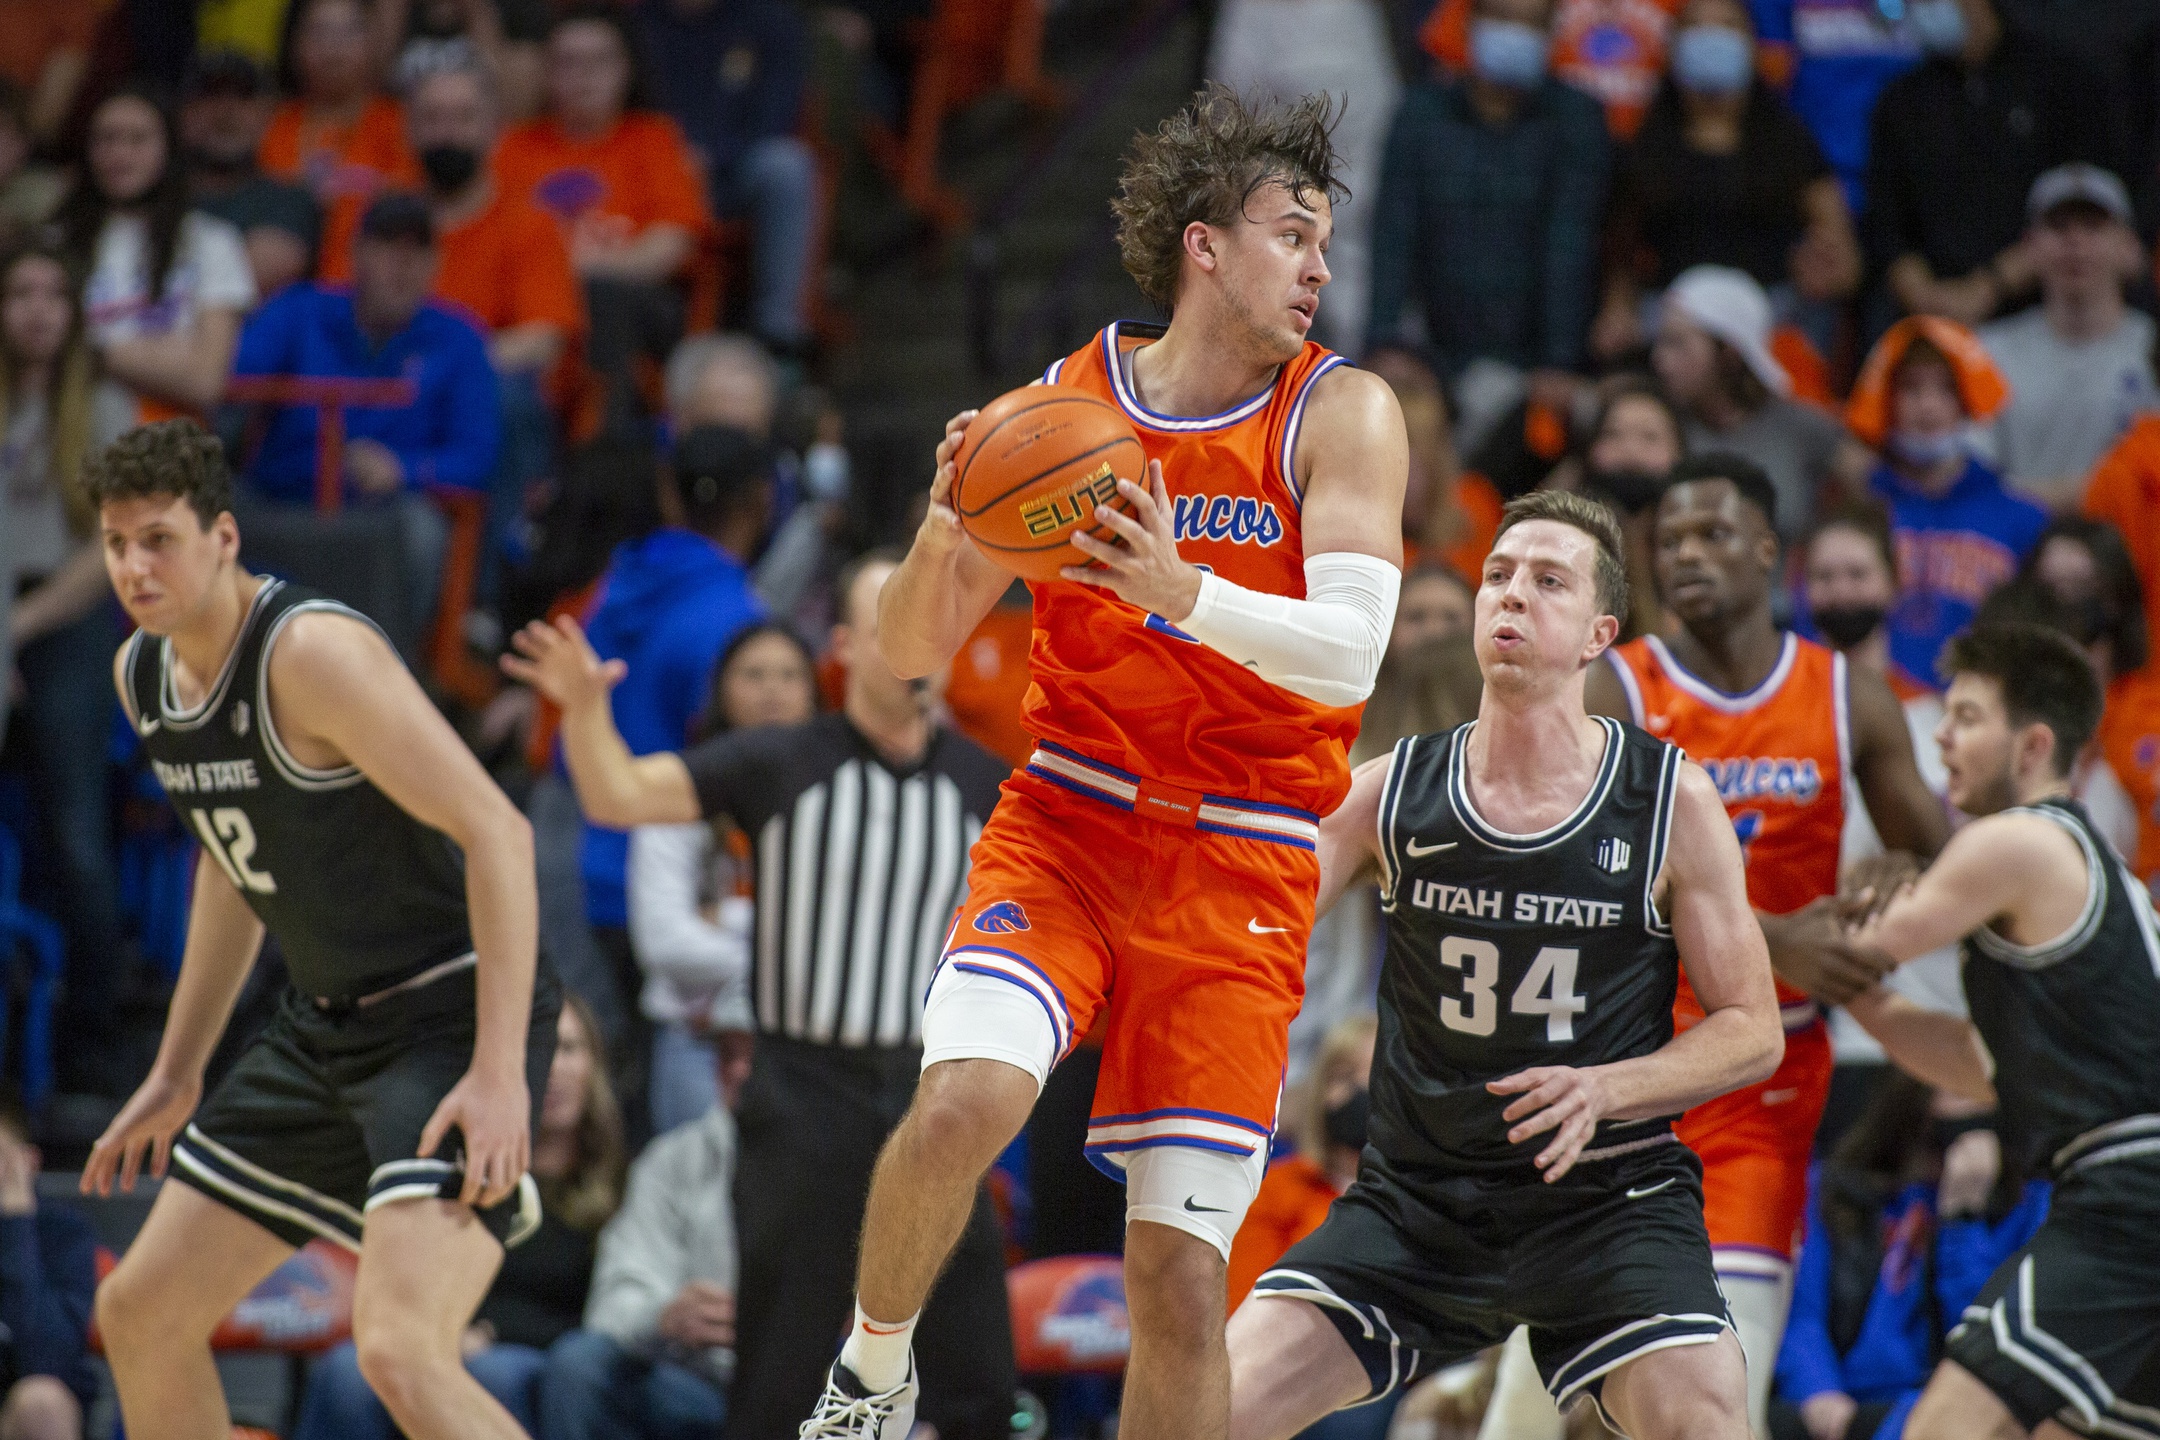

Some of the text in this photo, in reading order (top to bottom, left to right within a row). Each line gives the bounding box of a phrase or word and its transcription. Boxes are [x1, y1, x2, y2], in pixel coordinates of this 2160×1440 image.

[1173, 493, 1283, 548] ncos
[196, 758, 261, 791] STATE
[191, 807, 278, 894] 12
[1411, 879, 1623, 928] UTAH STATE
[1440, 935, 1586, 1042] 34
